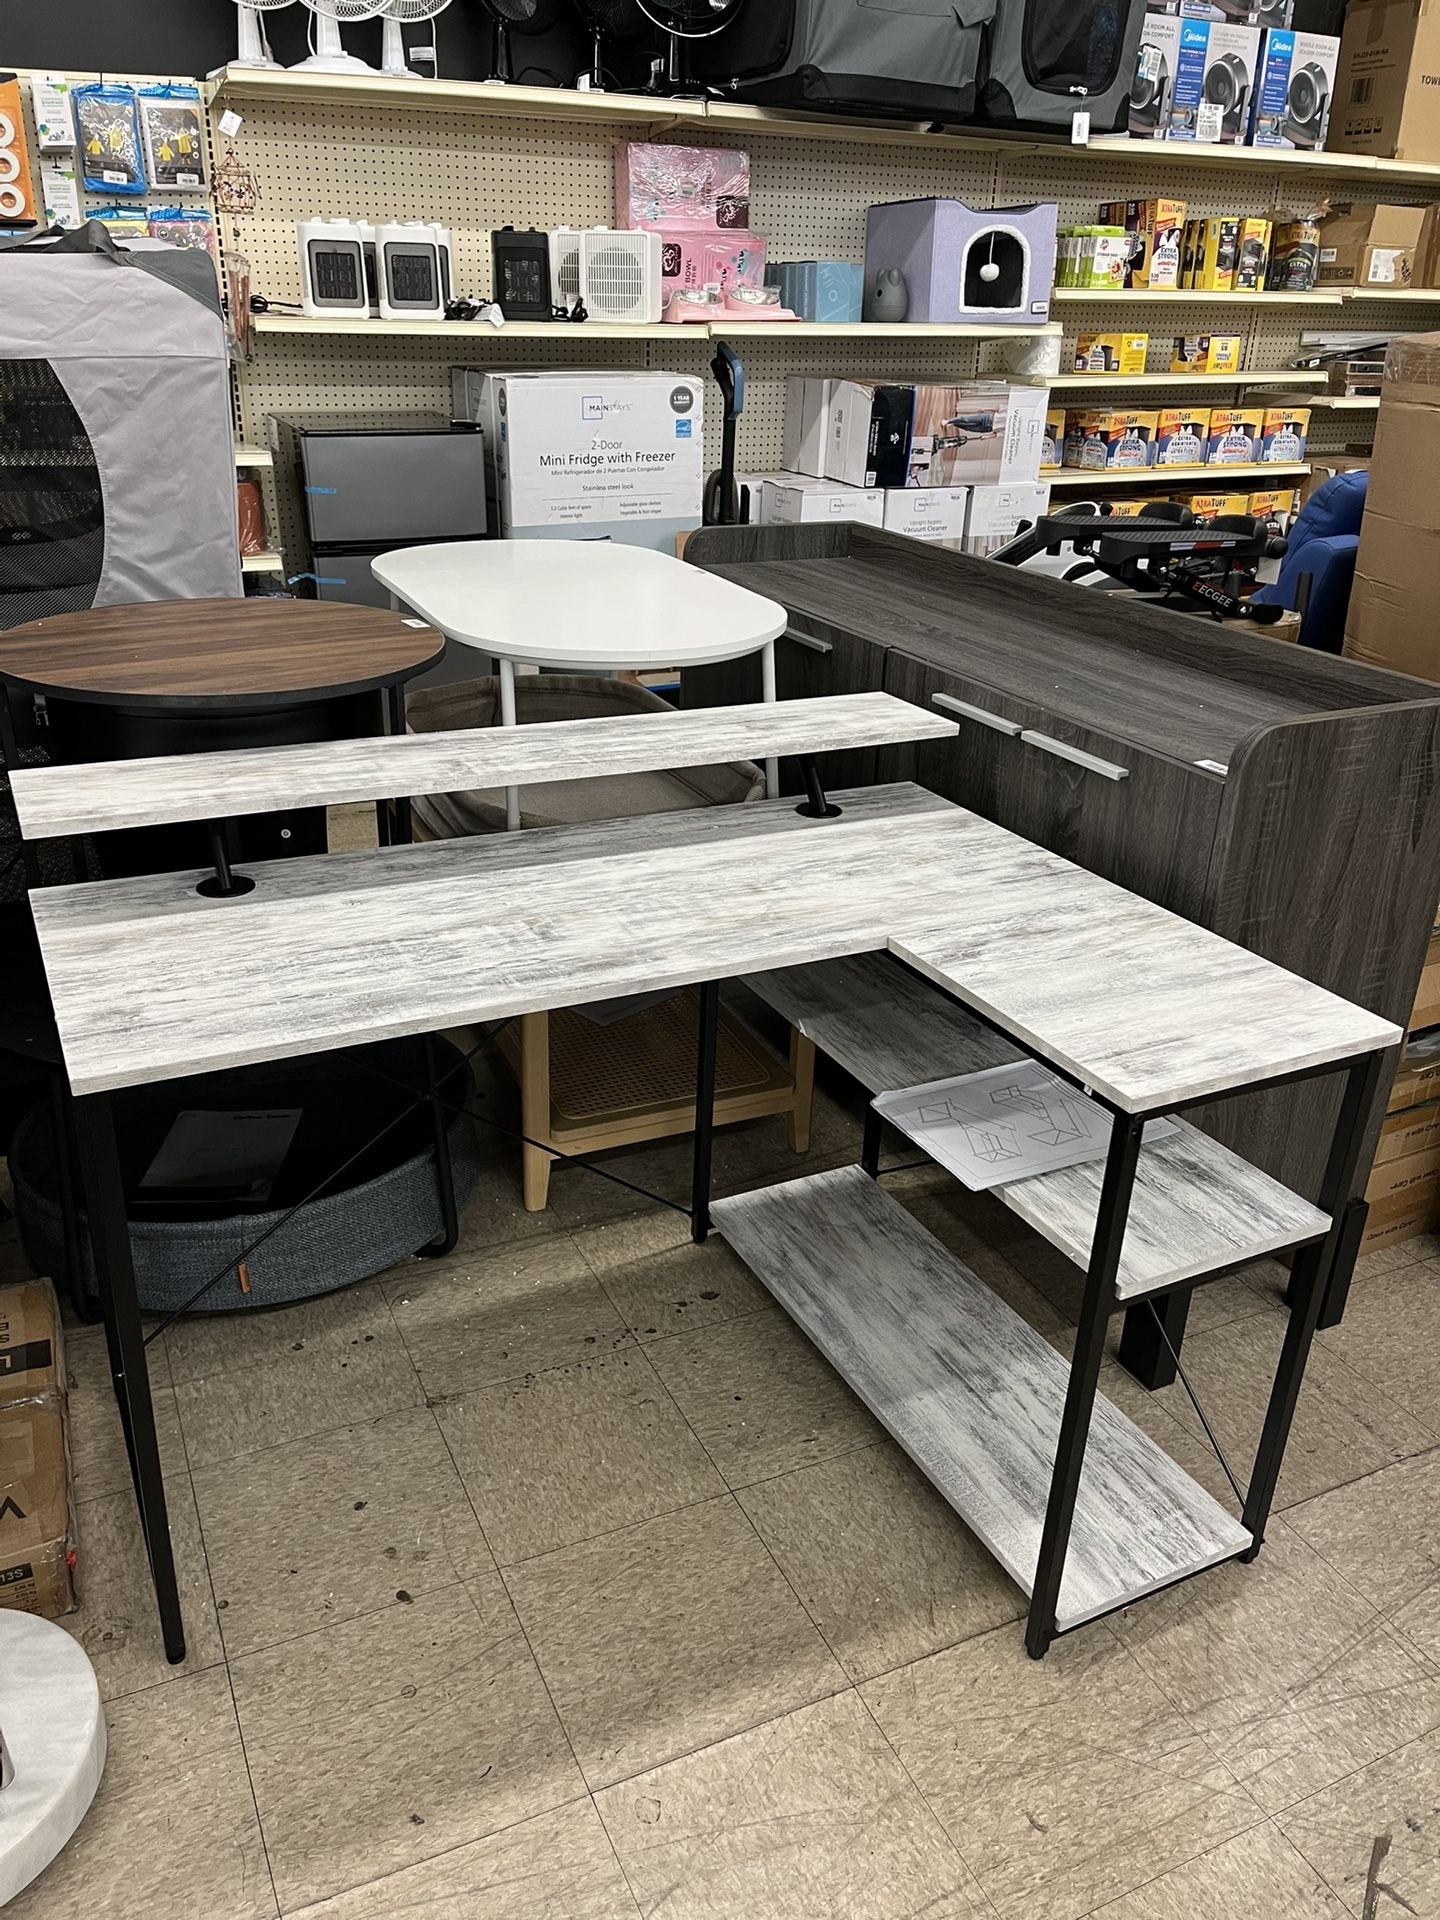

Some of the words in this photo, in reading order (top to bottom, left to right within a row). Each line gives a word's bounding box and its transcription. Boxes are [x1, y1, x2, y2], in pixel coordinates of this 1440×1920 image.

[1184, 29, 1206, 42] Midea
[1271, 38, 1292, 51] Midea
[589, 404, 631, 412] MAINSTAYS
[1011, 409, 1020, 438] Vacuum
[591, 440, 623, 451] 2-Door
[1007, 438, 1016, 465] Cleaner
[540, 455, 566, 466] Mini
[568, 453, 605, 467] Fridge
[607, 452, 632, 464] with
[635, 452, 676, 462] Freezer
[1196, 499, 1226, 508] XTRATUFF
[1192, 581, 1233, 608] EECGEE
